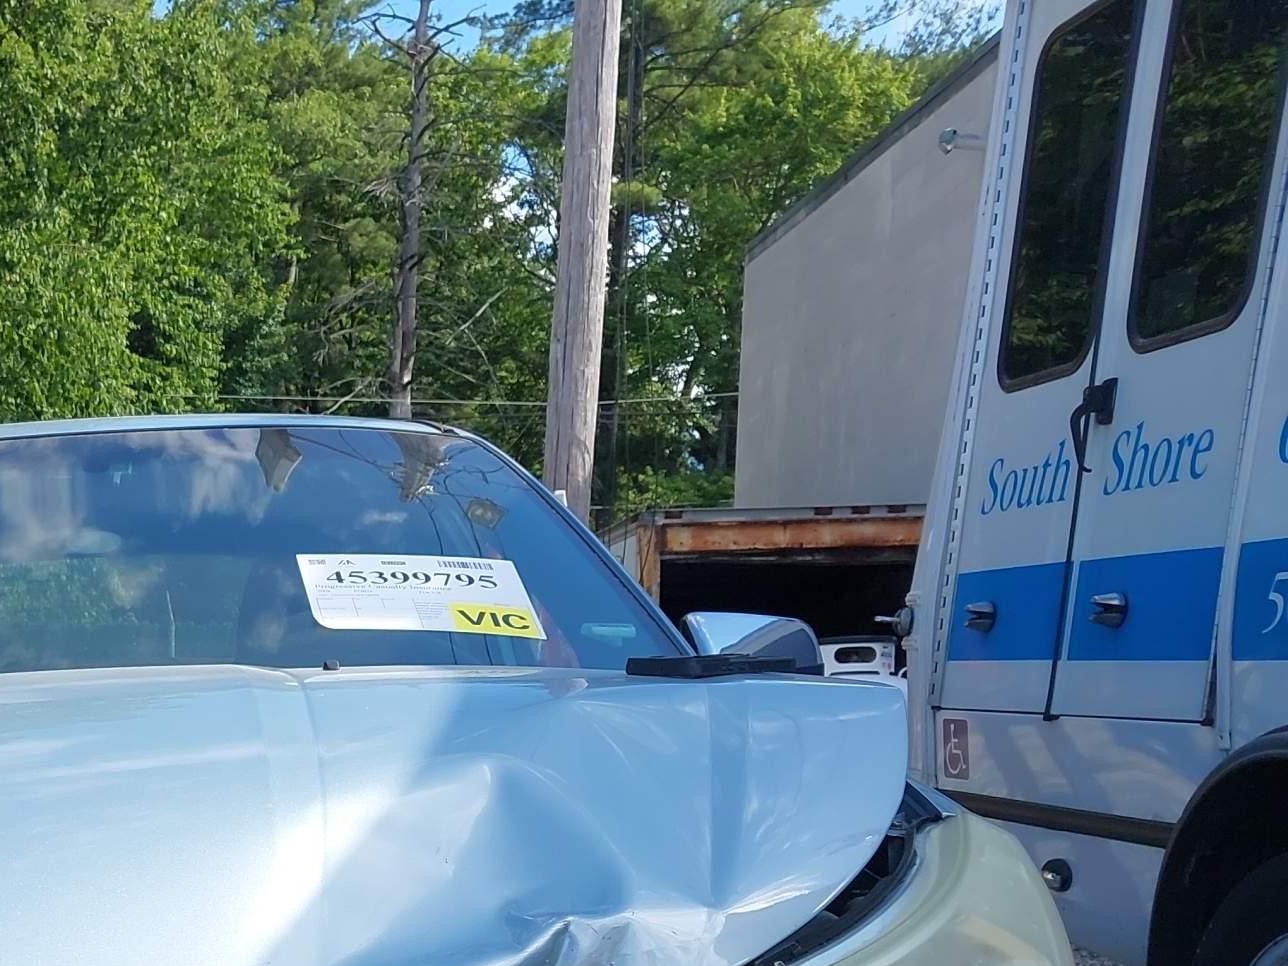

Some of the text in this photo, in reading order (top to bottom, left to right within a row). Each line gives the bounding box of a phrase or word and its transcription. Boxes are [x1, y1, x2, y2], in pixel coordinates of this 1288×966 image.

[980, 438, 1072, 515] South
[1102, 420, 1214, 496] Shore
[325, 570, 499, 589] 45399795
[456, 609, 531, 630] VIC
